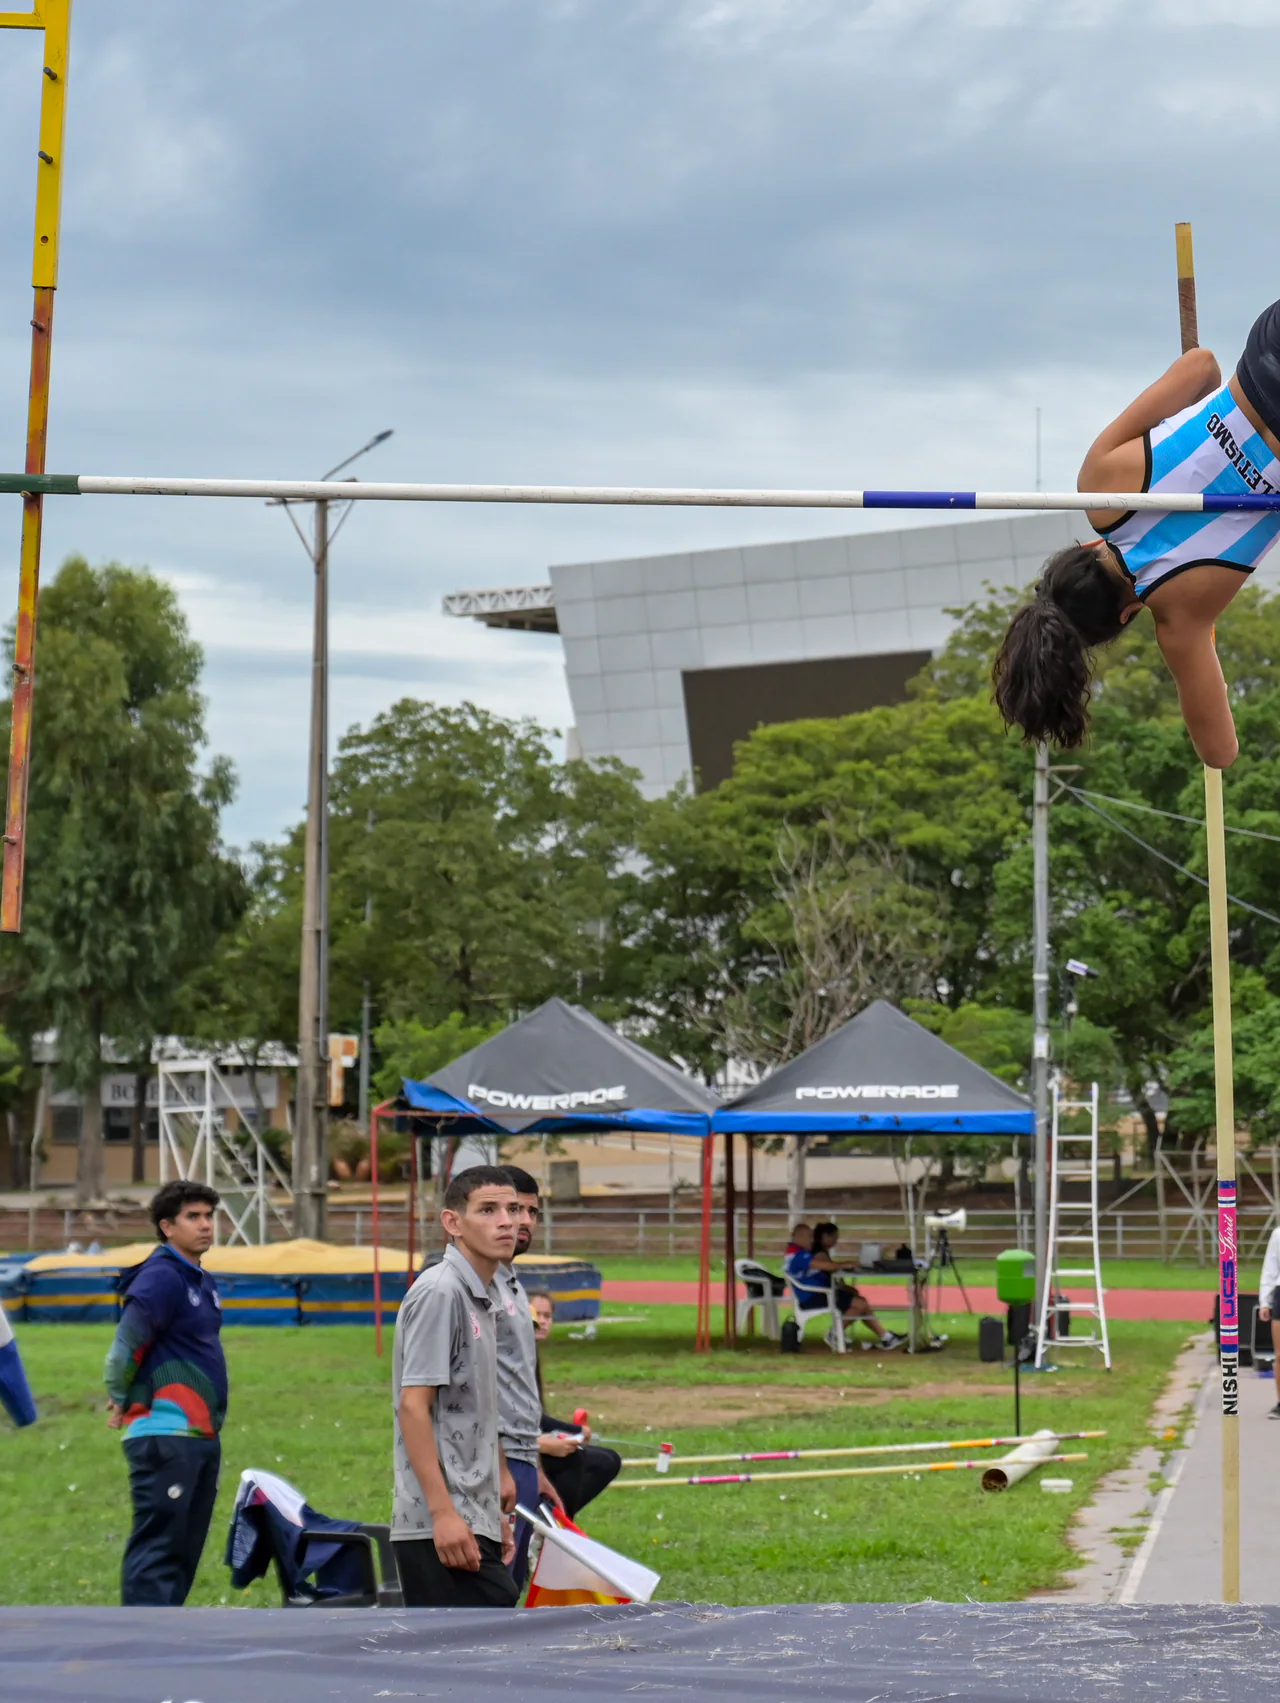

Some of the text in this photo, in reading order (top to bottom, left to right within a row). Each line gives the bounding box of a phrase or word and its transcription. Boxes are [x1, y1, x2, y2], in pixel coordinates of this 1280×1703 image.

[1206, 413, 1280, 494] LETISMO
[468, 1083, 628, 1110] POWERADE
[796, 1085, 959, 1099] POWERADE
[1218, 1213, 1237, 1318] UCS Spirit
[1222, 1357, 1238, 1415] NISHI
